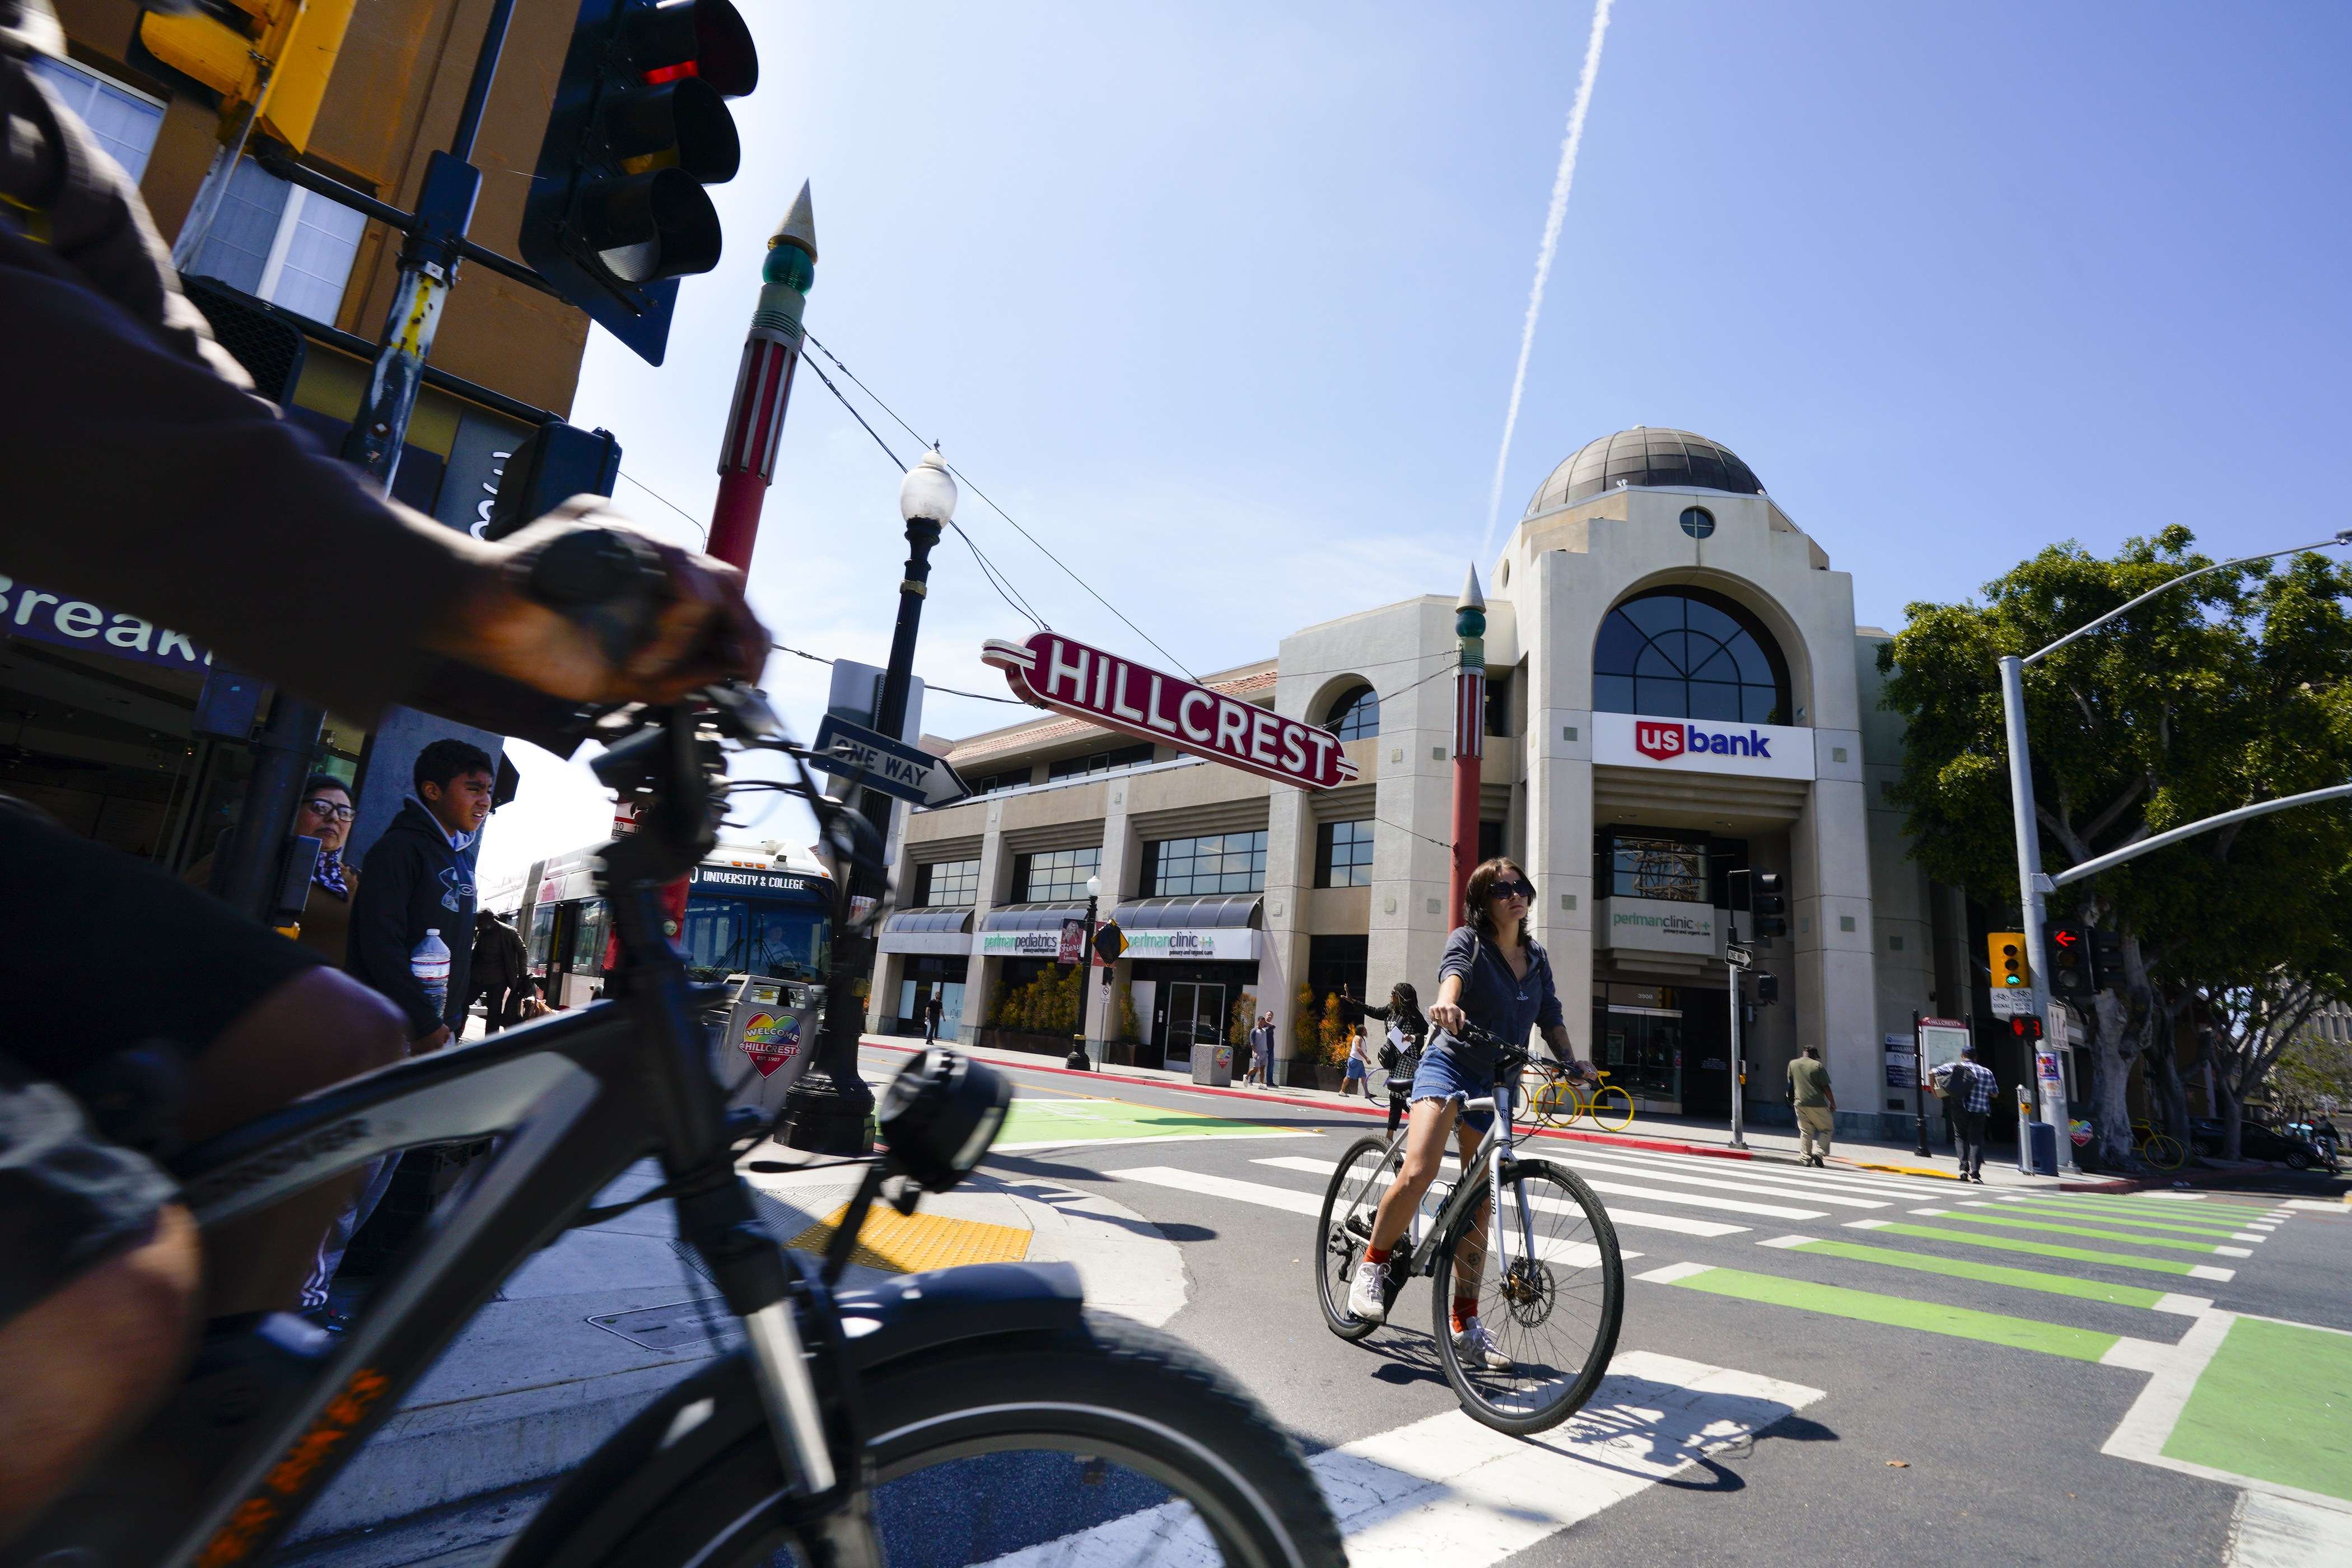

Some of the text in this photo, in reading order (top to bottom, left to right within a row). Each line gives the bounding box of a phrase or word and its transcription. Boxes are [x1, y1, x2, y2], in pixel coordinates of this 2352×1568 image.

[1046, 640, 1335, 781] HILLCREST
[1641, 725, 1772, 758] us bank
[834, 739, 929, 787] ONE WAY
[615, 822, 624, 830] 10
[703, 870, 758, 886] UNIVERSITY
[760, 876, 767, 887] &
[768, 876, 805, 890] COLLEGE
[1059, 943, 1082, 954] Fiery
[745, 1027, 799, 1043] WELCOME
[2032, 1020, 2041, 1037] 3
[744, 1042, 796, 1054] HILLCREST
